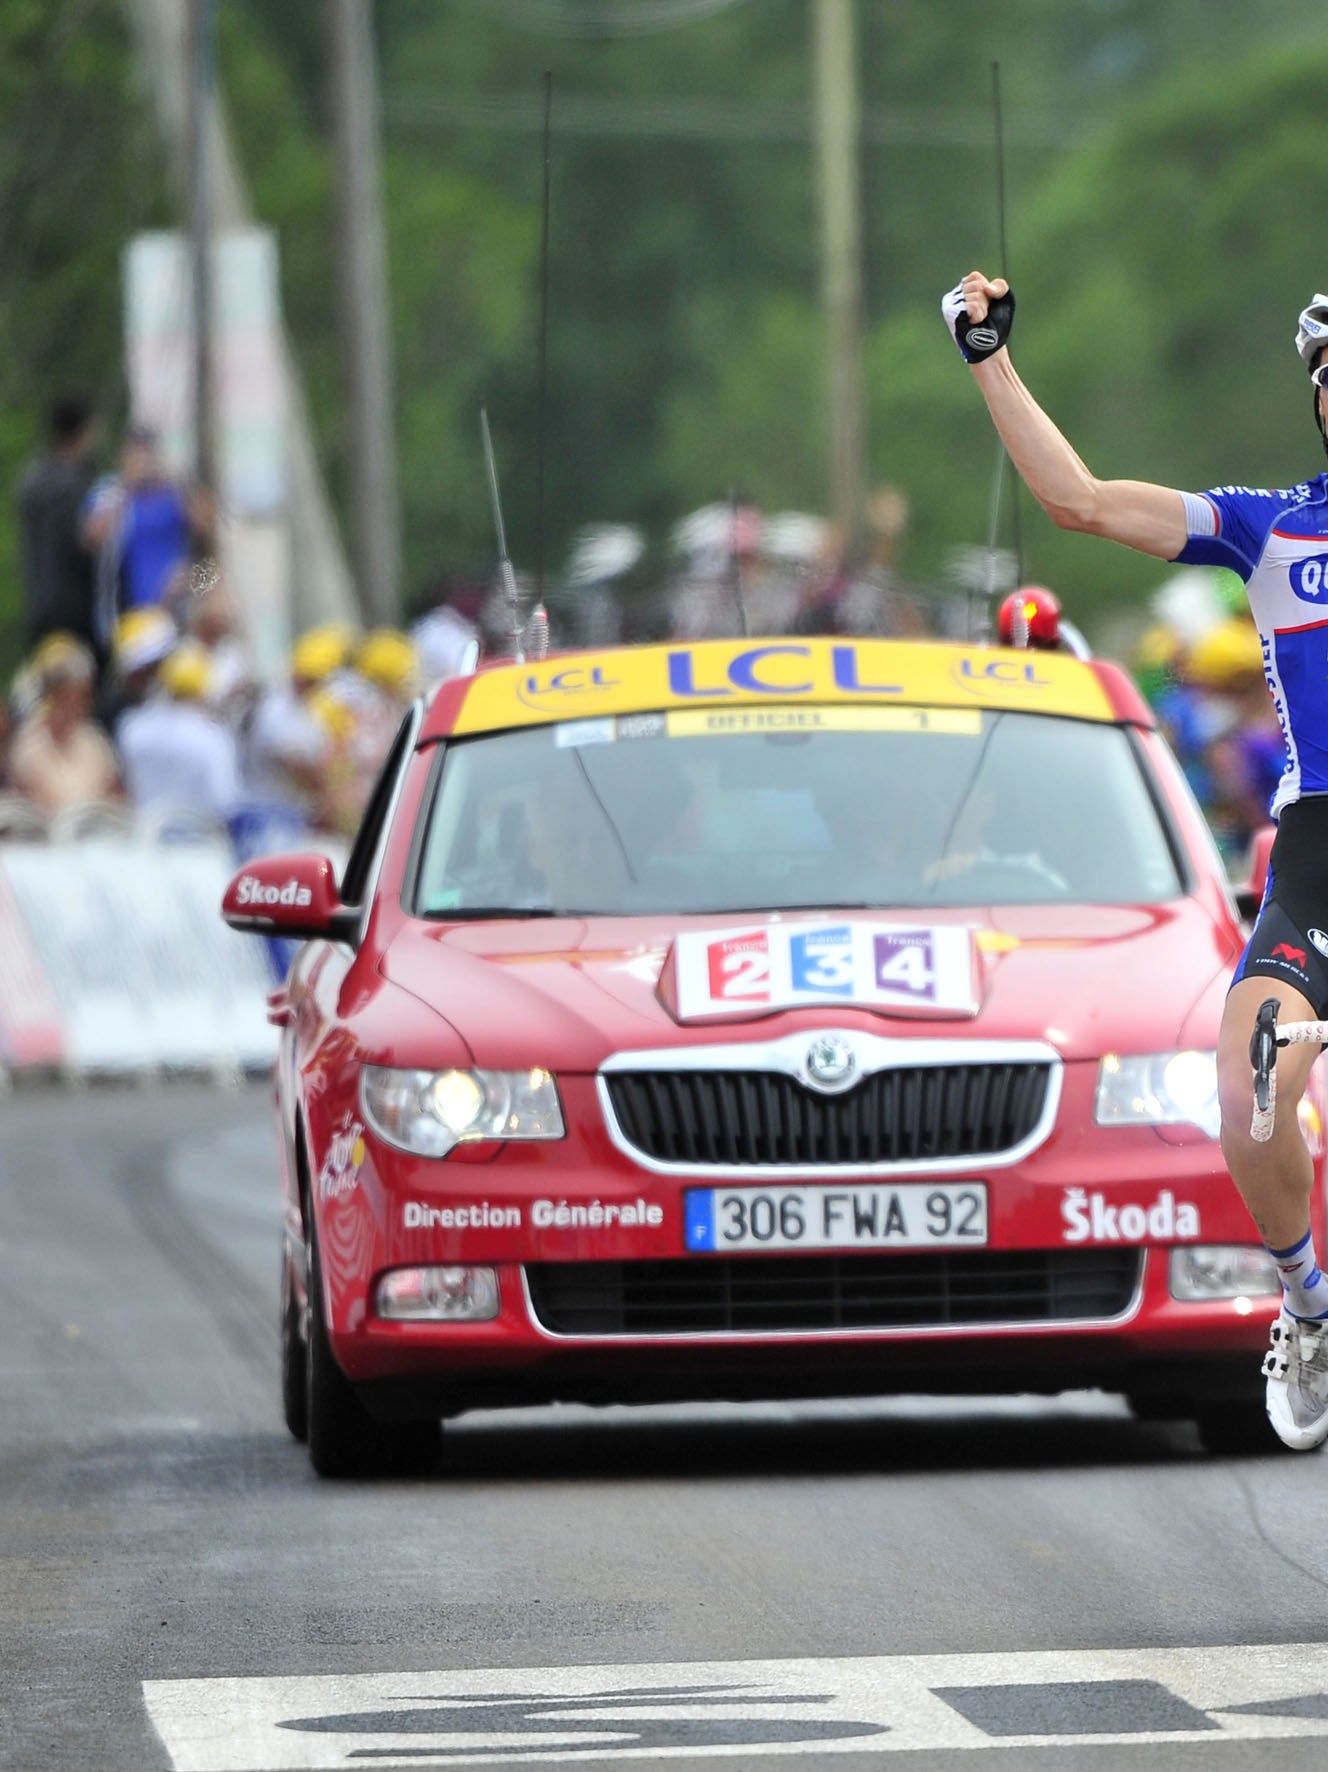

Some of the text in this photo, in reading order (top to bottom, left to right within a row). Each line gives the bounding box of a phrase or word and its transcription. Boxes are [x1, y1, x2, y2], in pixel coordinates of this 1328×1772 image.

[526, 665, 620, 696] LCL
[667, 645, 904, 697] LCL
[960, 658, 1053, 685] LCL
[237, 874, 312, 908] Škoda
[722, 953, 770, 998] 2
[805, 944, 852, 987] 3
[881, 946, 932, 991] 4
[403, 1198, 664, 1229] Direction Générale
[694, 1225, 706, 1241] F
[721, 1191, 985, 1242] 306 FWA 92
[1061, 1186, 1199, 1242] Škoda
